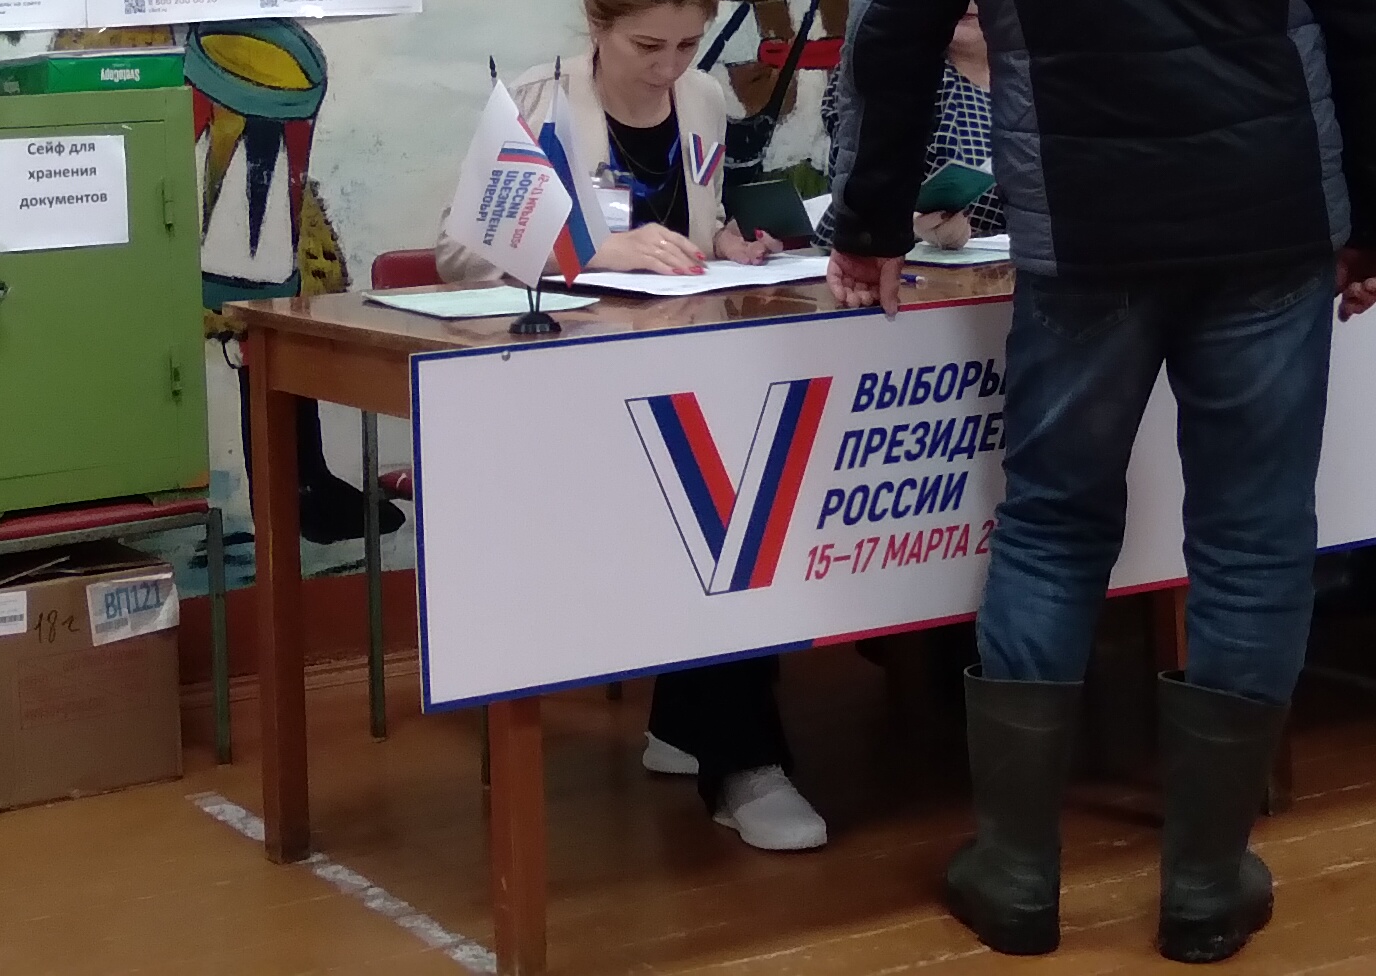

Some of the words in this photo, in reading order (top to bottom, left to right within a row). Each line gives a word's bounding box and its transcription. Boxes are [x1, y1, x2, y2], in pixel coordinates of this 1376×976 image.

[27, 141, 65, 156] Сейф
[69, 141, 96, 155] для
[28, 166, 97, 182] хранения
[19, 191, 108, 210] документов
[834, 411, 1006, 471] ПРЕЗИДЕ
[817, 470, 969, 530] РОССИИ
[882, 524, 970, 573] МАРТА
